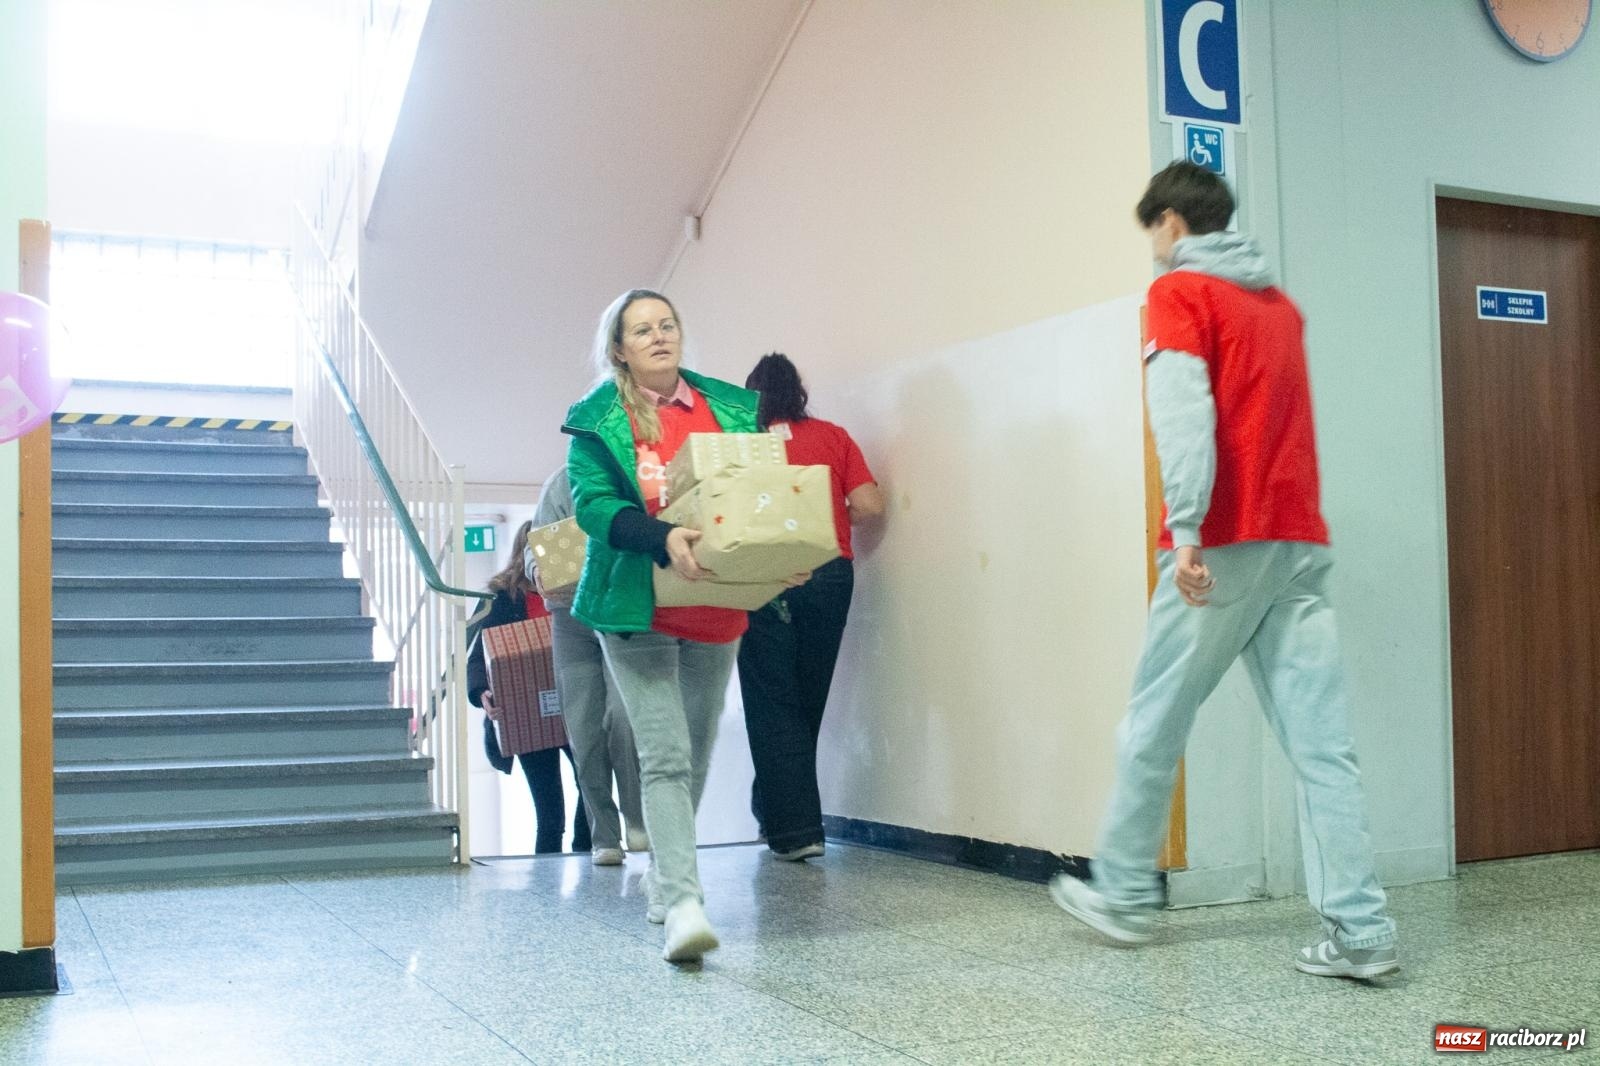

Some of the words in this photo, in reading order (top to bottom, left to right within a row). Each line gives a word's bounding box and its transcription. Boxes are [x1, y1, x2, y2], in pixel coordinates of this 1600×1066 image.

[1536, 31, 1545, 49] 6
[1178, 0, 1227, 110] C
[1204, 133, 1218, 145] WC
[1507, 296, 1534, 306] SKLEPIK
[1507, 306, 1536, 316] SZKOLNY
